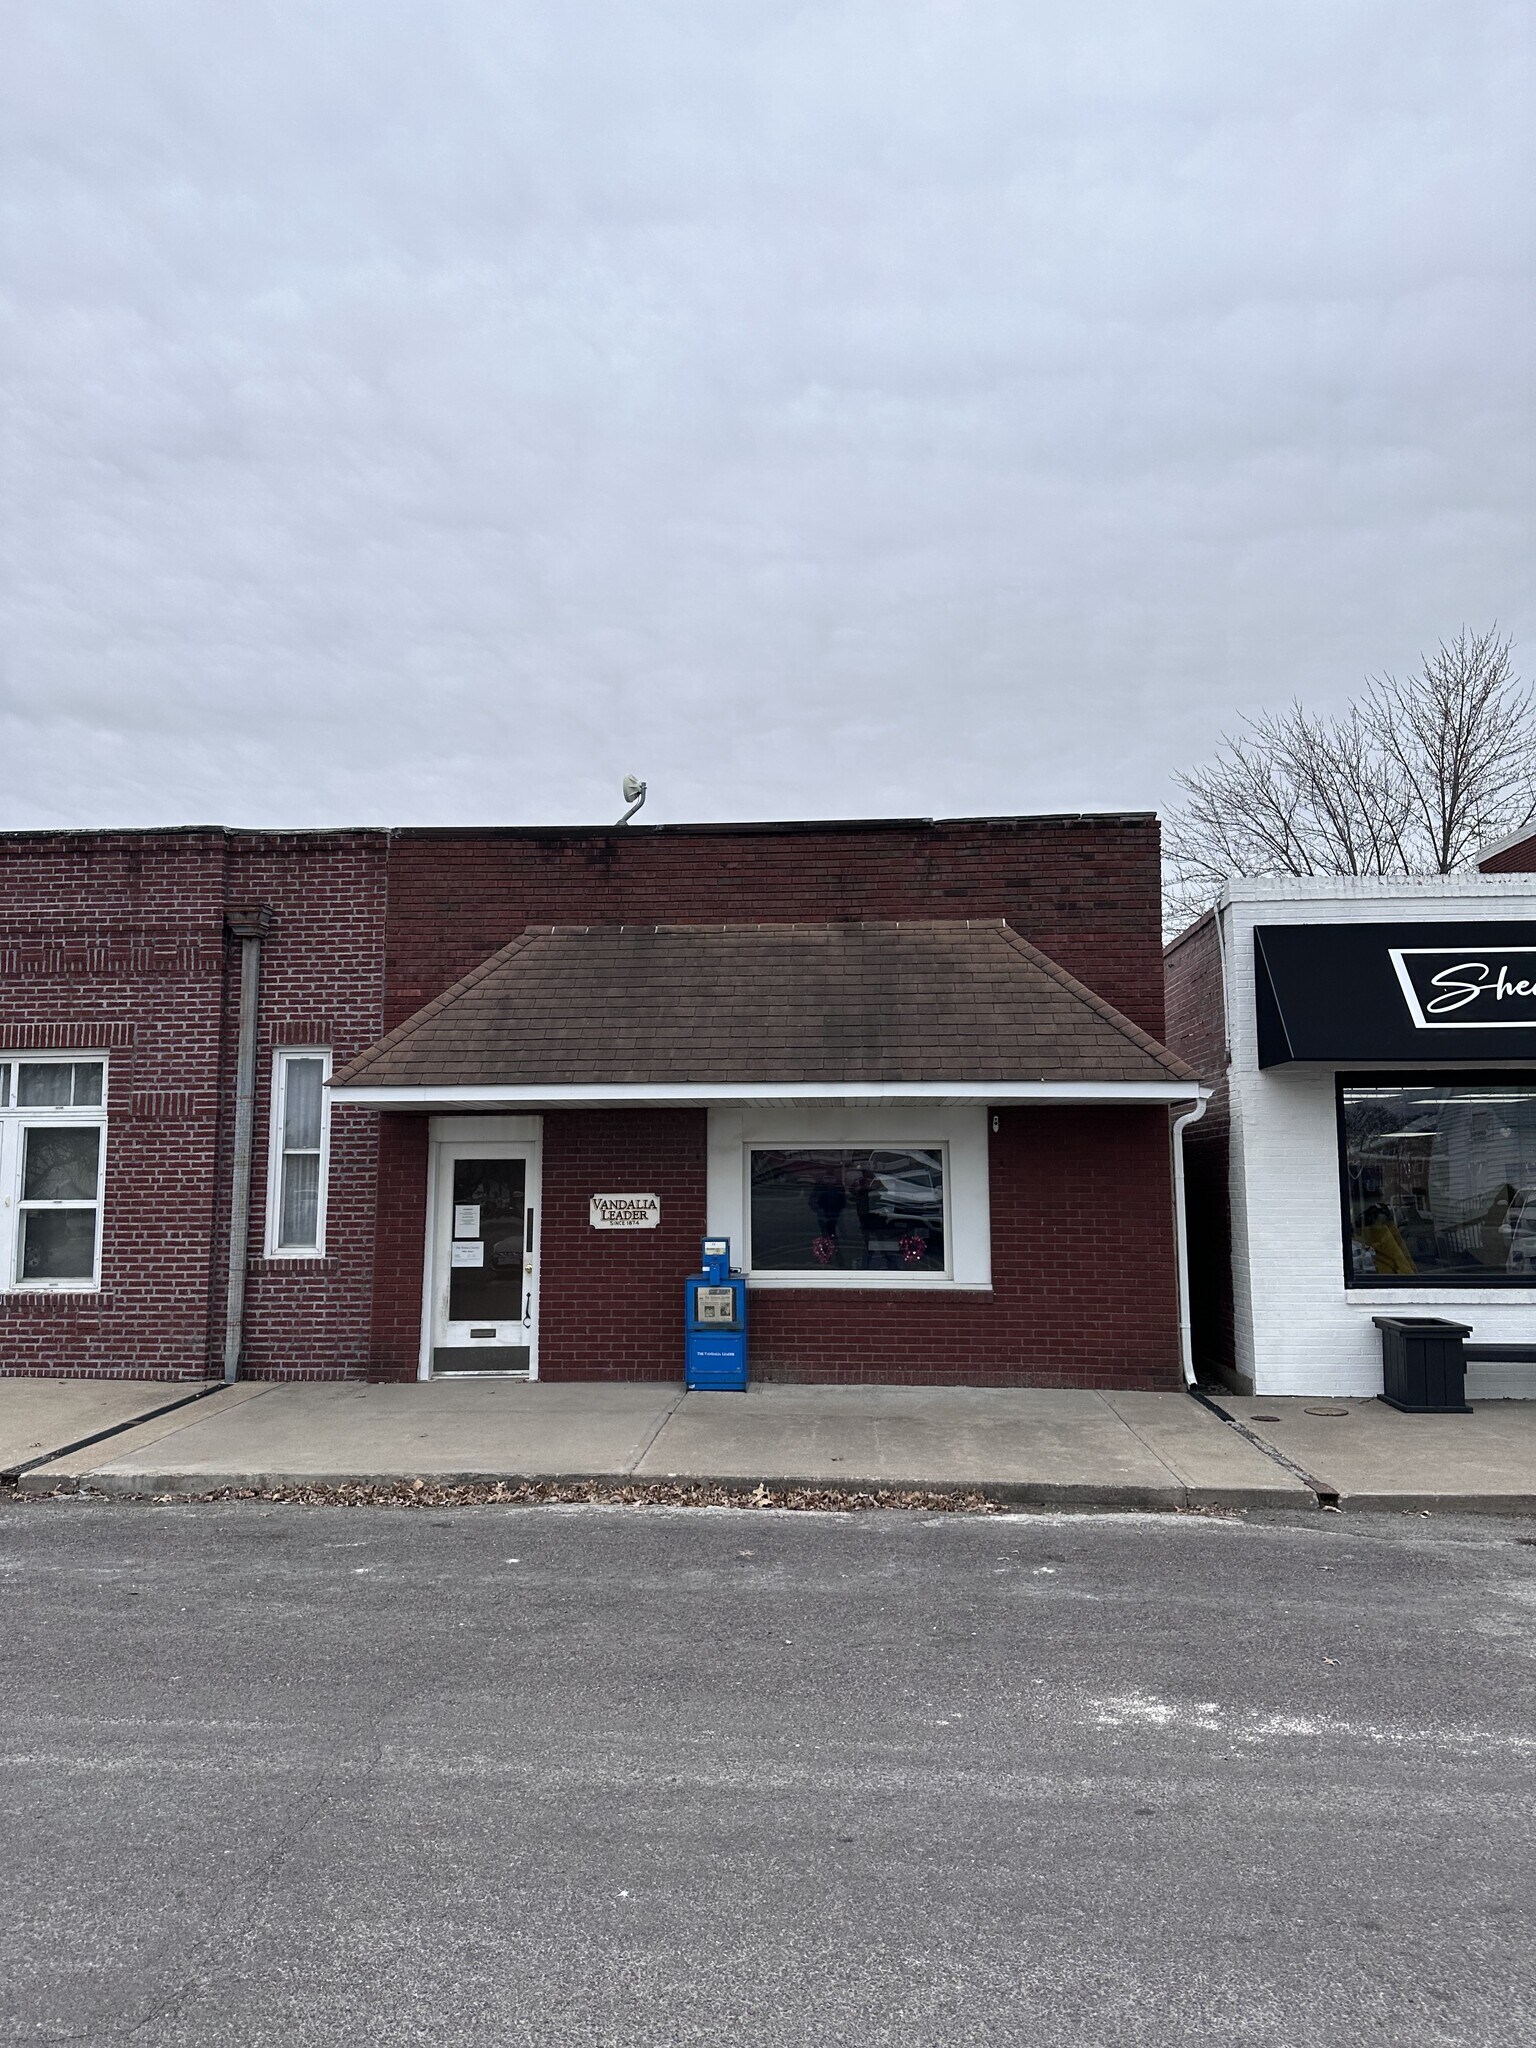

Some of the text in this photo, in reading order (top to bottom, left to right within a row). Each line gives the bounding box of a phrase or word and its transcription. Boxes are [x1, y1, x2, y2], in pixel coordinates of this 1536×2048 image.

[1426, 962, 1536, 1014] She
[593, 1199, 658, 1210] VANDALIA
[602, 1210, 649, 1220] LEADER
